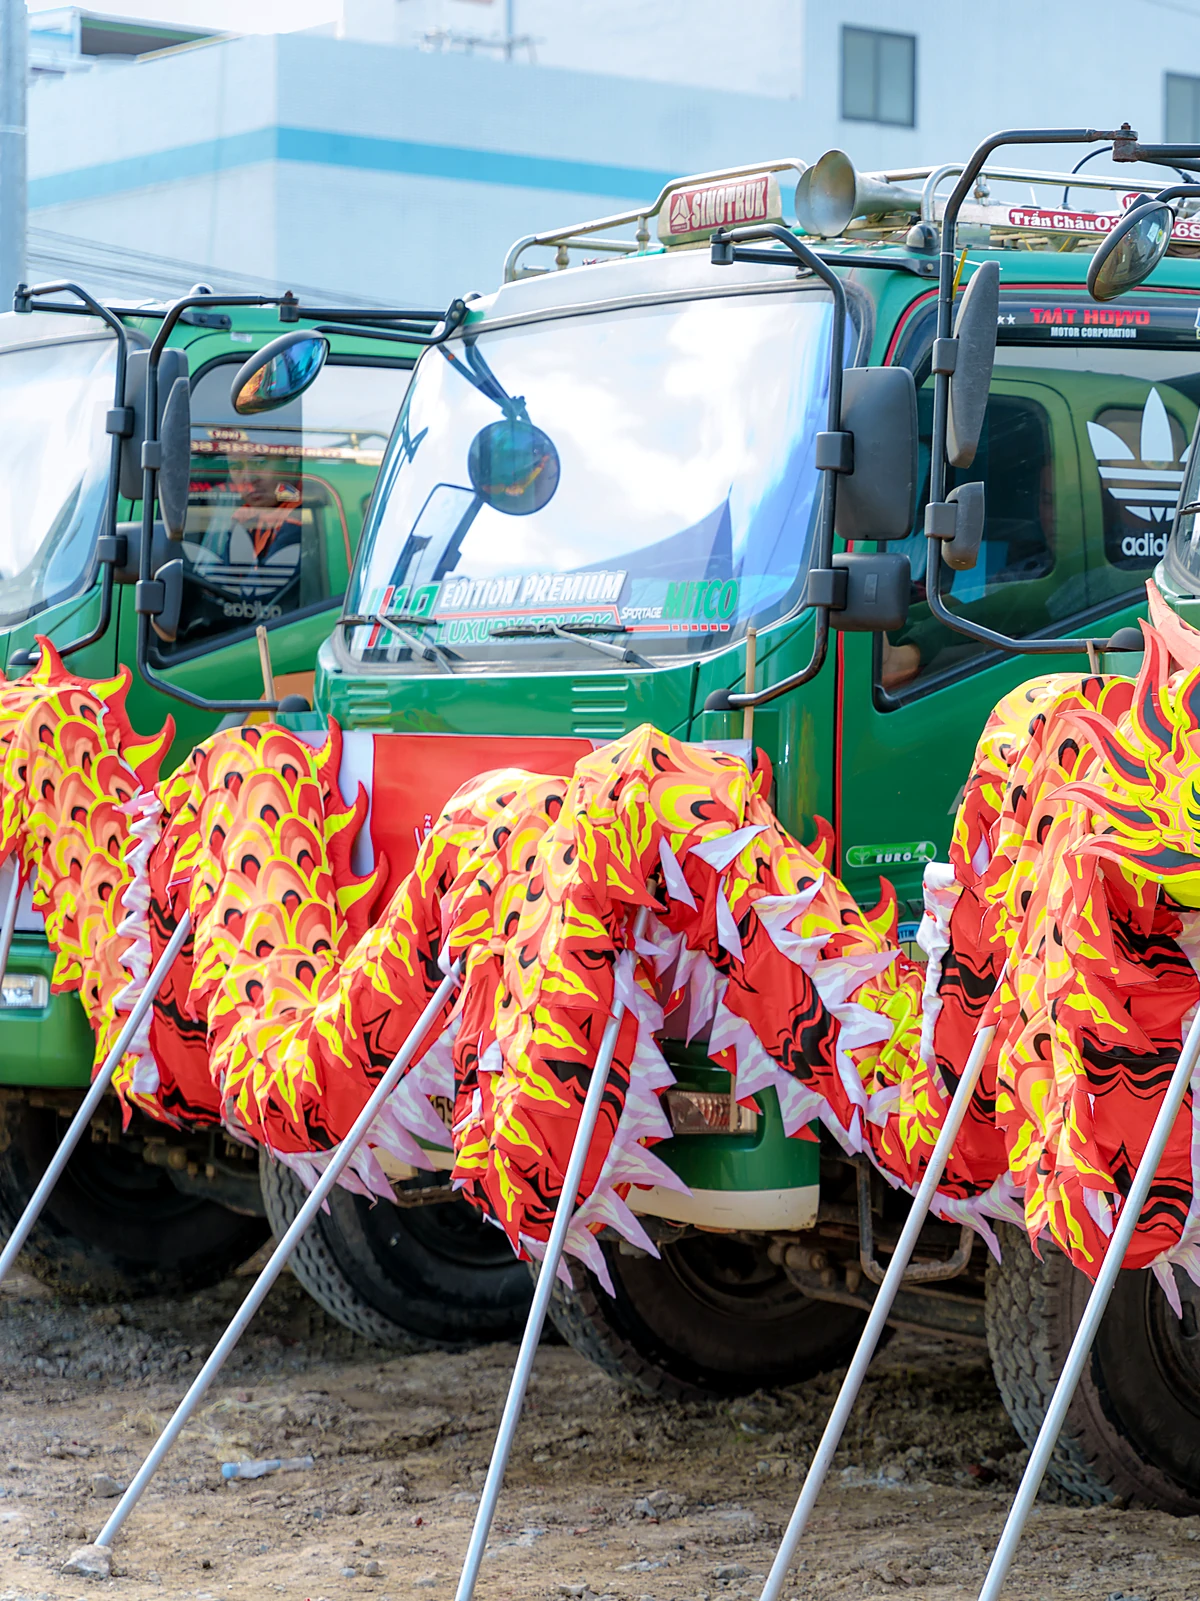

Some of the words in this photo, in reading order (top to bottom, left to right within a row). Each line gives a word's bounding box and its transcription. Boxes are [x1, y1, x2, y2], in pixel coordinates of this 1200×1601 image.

[691, 181, 766, 228] SINOTRUK
[1053, 214, 1095, 230] Châu
[1030, 307, 1077, 325] TMT
[1084, 309, 1150, 327] HOWO
[1051, 326, 1080, 338] MOTOR
[1081, 327, 1137, 339] CORPORATION
[1121, 532, 1168, 556] adid
[439, 576, 522, 609] EDITION
[520, 571, 626, 603] PREMIUM
[621, 606, 662, 619] SPORTAGE
[661, 579, 738, 619] MITCO
[876, 852, 912, 864] EURO
